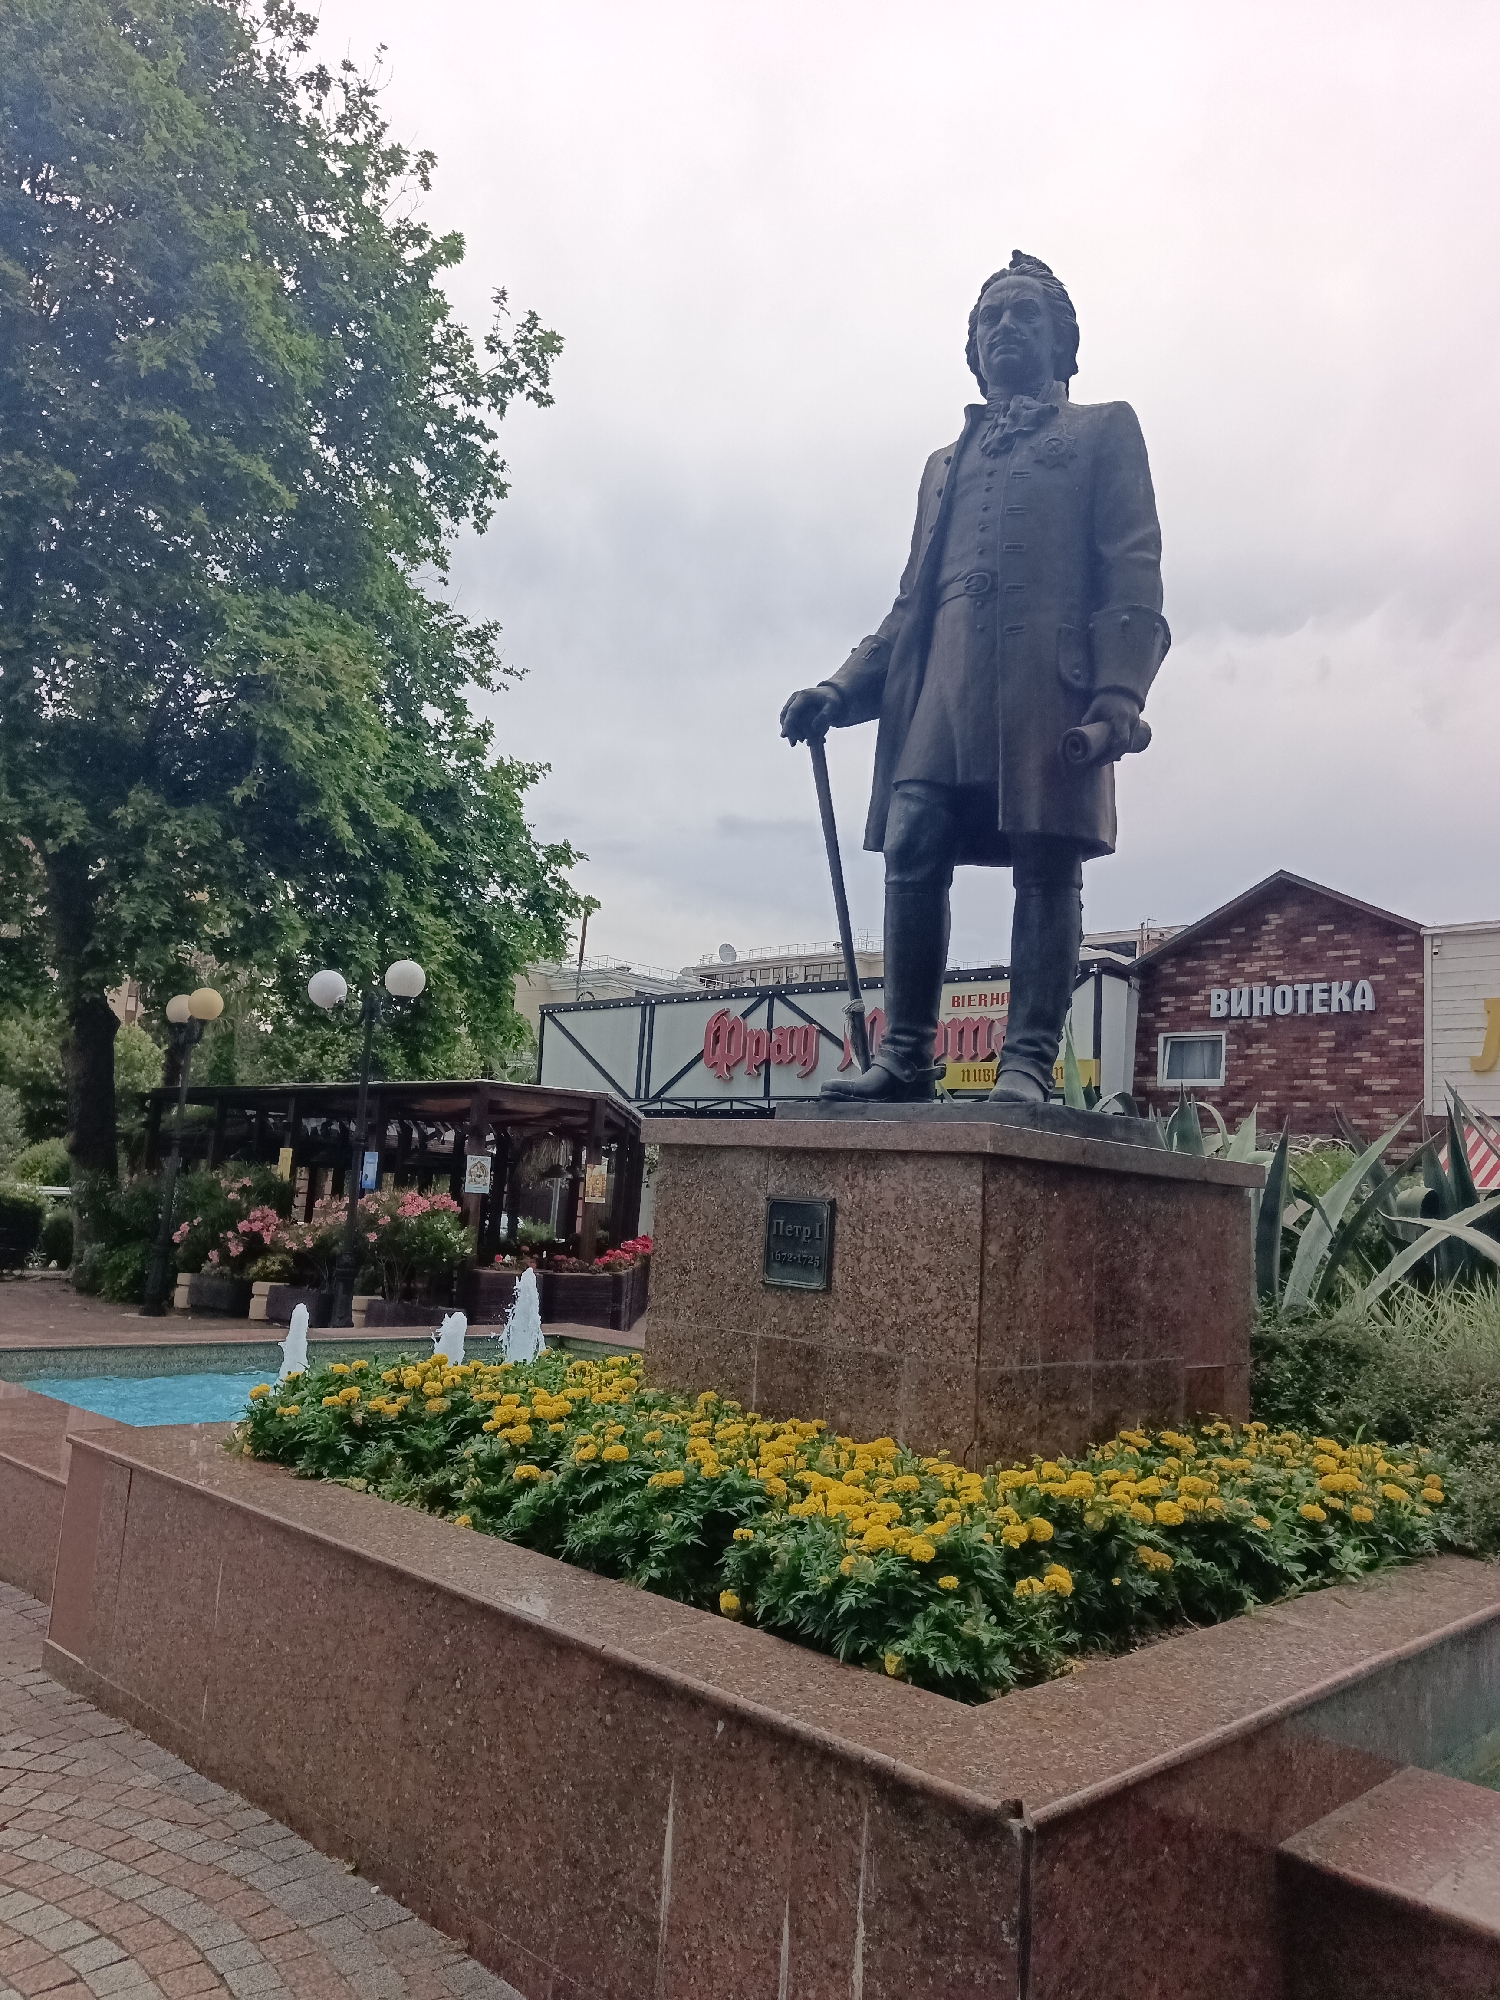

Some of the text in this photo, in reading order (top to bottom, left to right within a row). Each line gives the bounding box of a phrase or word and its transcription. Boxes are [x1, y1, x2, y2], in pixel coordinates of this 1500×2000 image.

[951, 992, 1010, 1007] BIERHA
[1210, 980, 1375, 1018] ВИНОТЕКА
[704, 1008, 820, 1080] Фрау
[772, 1219, 823, 1243] Петр I
[770, 1251, 820, 1267] 1672-1725
